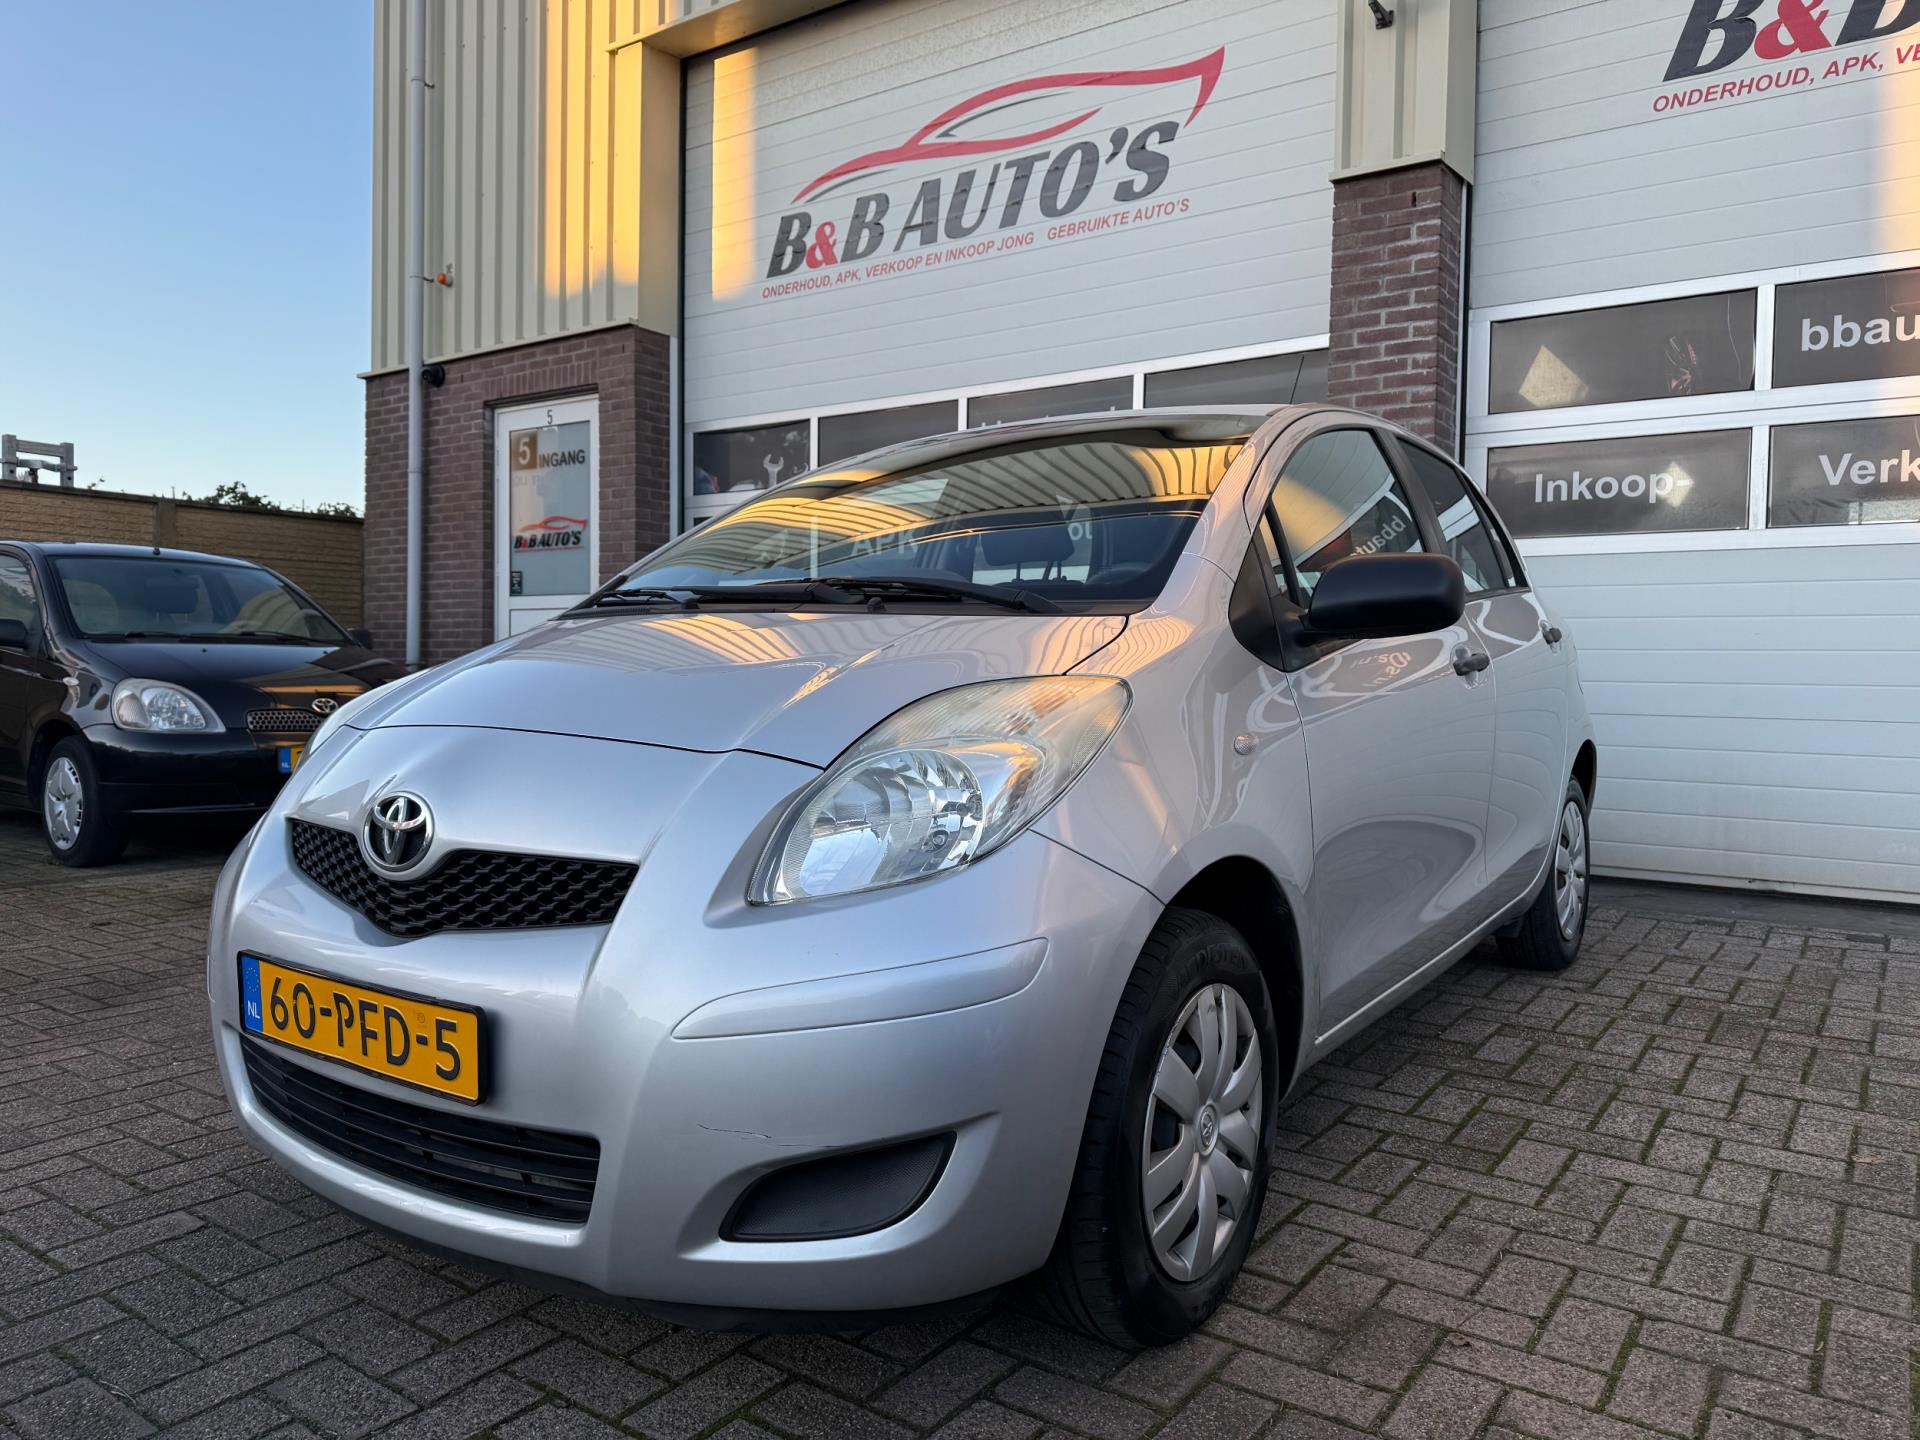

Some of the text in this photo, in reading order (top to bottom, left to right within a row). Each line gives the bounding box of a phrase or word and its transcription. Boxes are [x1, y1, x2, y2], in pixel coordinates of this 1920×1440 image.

[1652, 67, 1815, 113] ONDERHOUD,
[1822, 52, 1884, 79] APK,
[766, 121, 1180, 278] B&B AUTO'S
[762, 198, 1190, 299] ONDERHOUD, APK, VERKOOP EN INKOOP JONG GEBRUIKTE AUTO'S
[1801, 314, 1920, 352] bbau
[547, 409, 553, 425] 5
[518, 437, 531, 465] 5
[539, 449, 585, 468] INGANG
[537, 531, 582, 547] AUTO'S
[248, 1000, 260, 1019] NL
[270, 976, 461, 1081] 60-PFD-5
